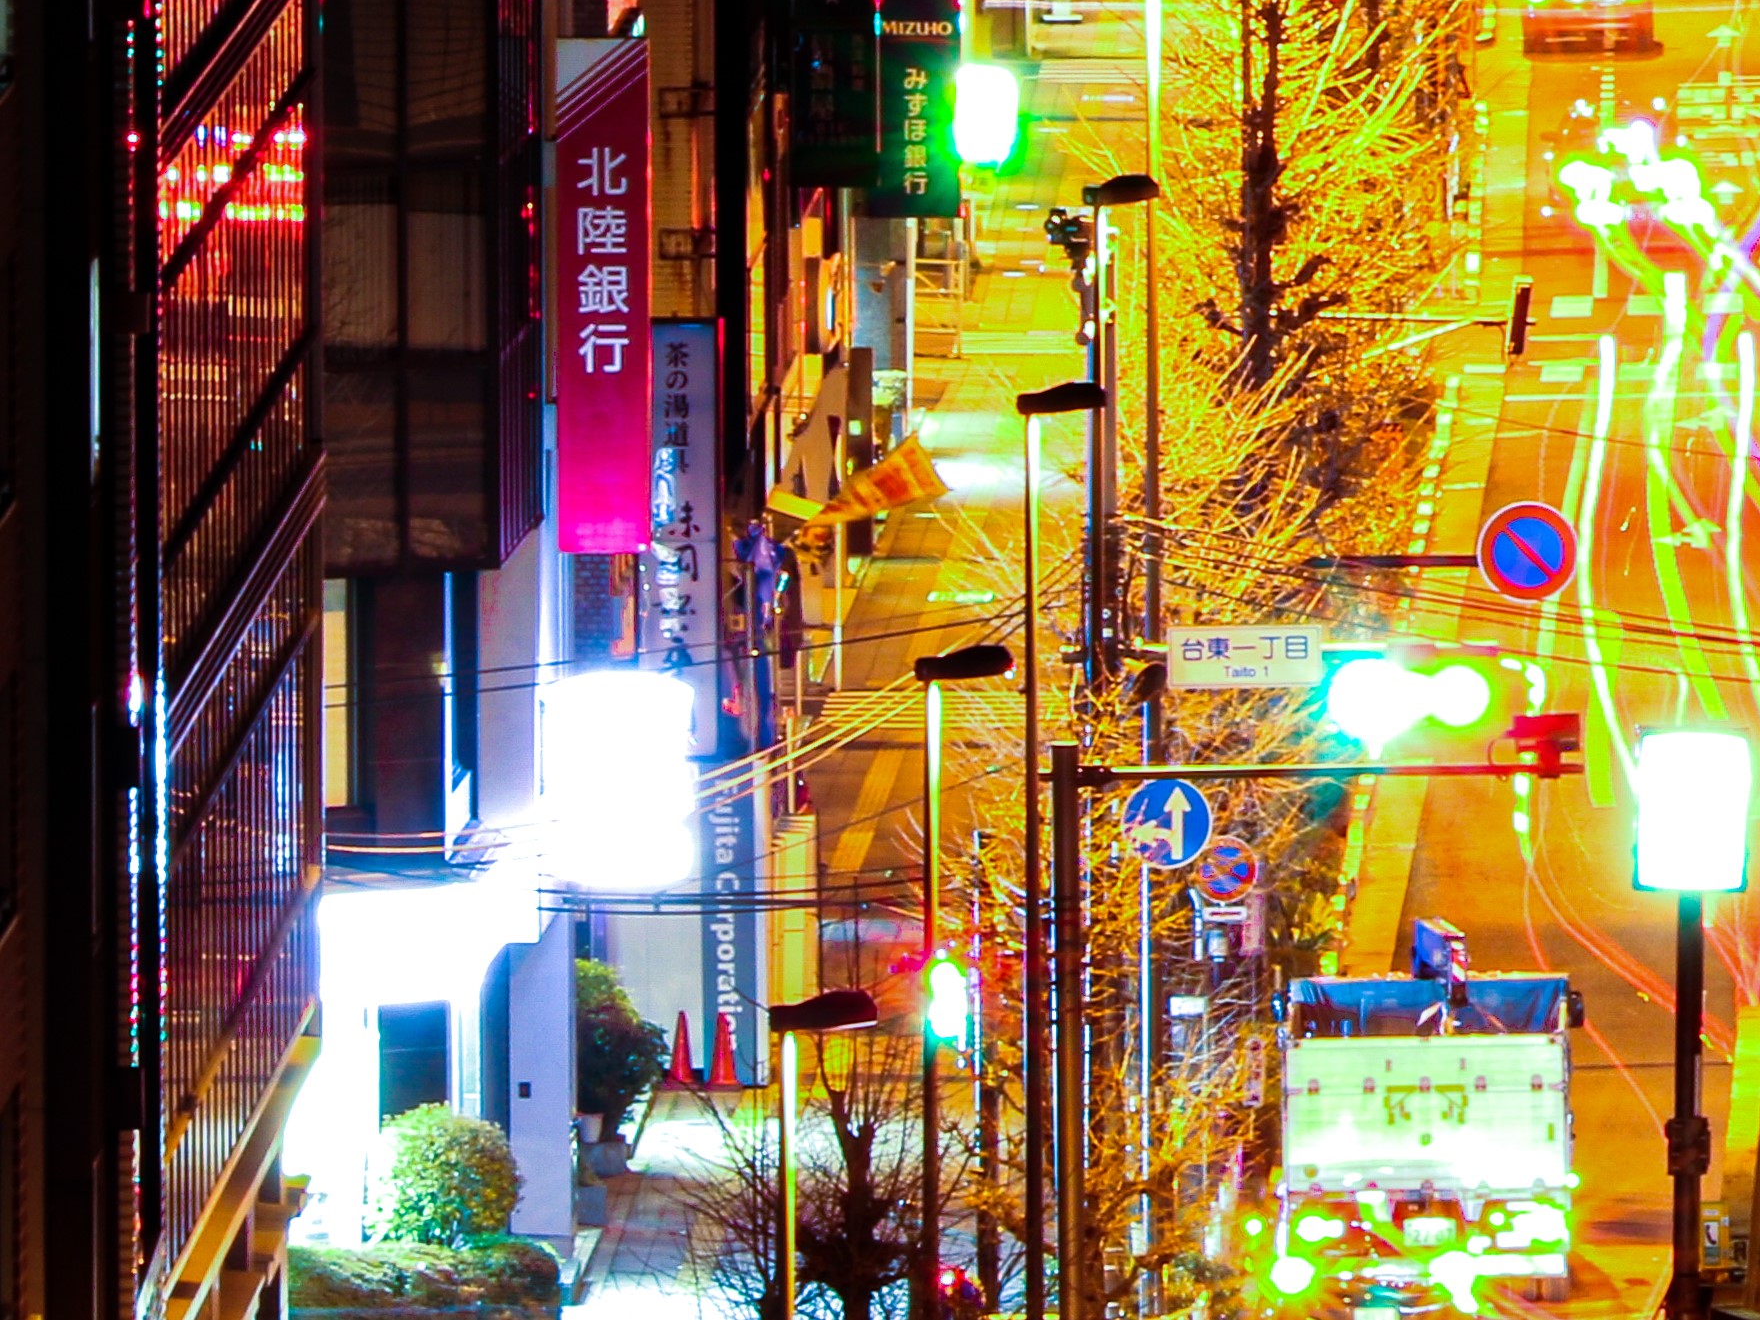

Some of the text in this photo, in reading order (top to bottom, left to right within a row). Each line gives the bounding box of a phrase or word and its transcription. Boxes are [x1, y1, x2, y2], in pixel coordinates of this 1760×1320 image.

[881, 20, 953, 37] MIZUHO
[902, 67, 929, 197] みずほ銀行
[576, 146, 630, 375] 北陸銀行
[1180, 635, 1309, 661] 台東一丁目
[1224, 665, 1270, 679] Taito 1
